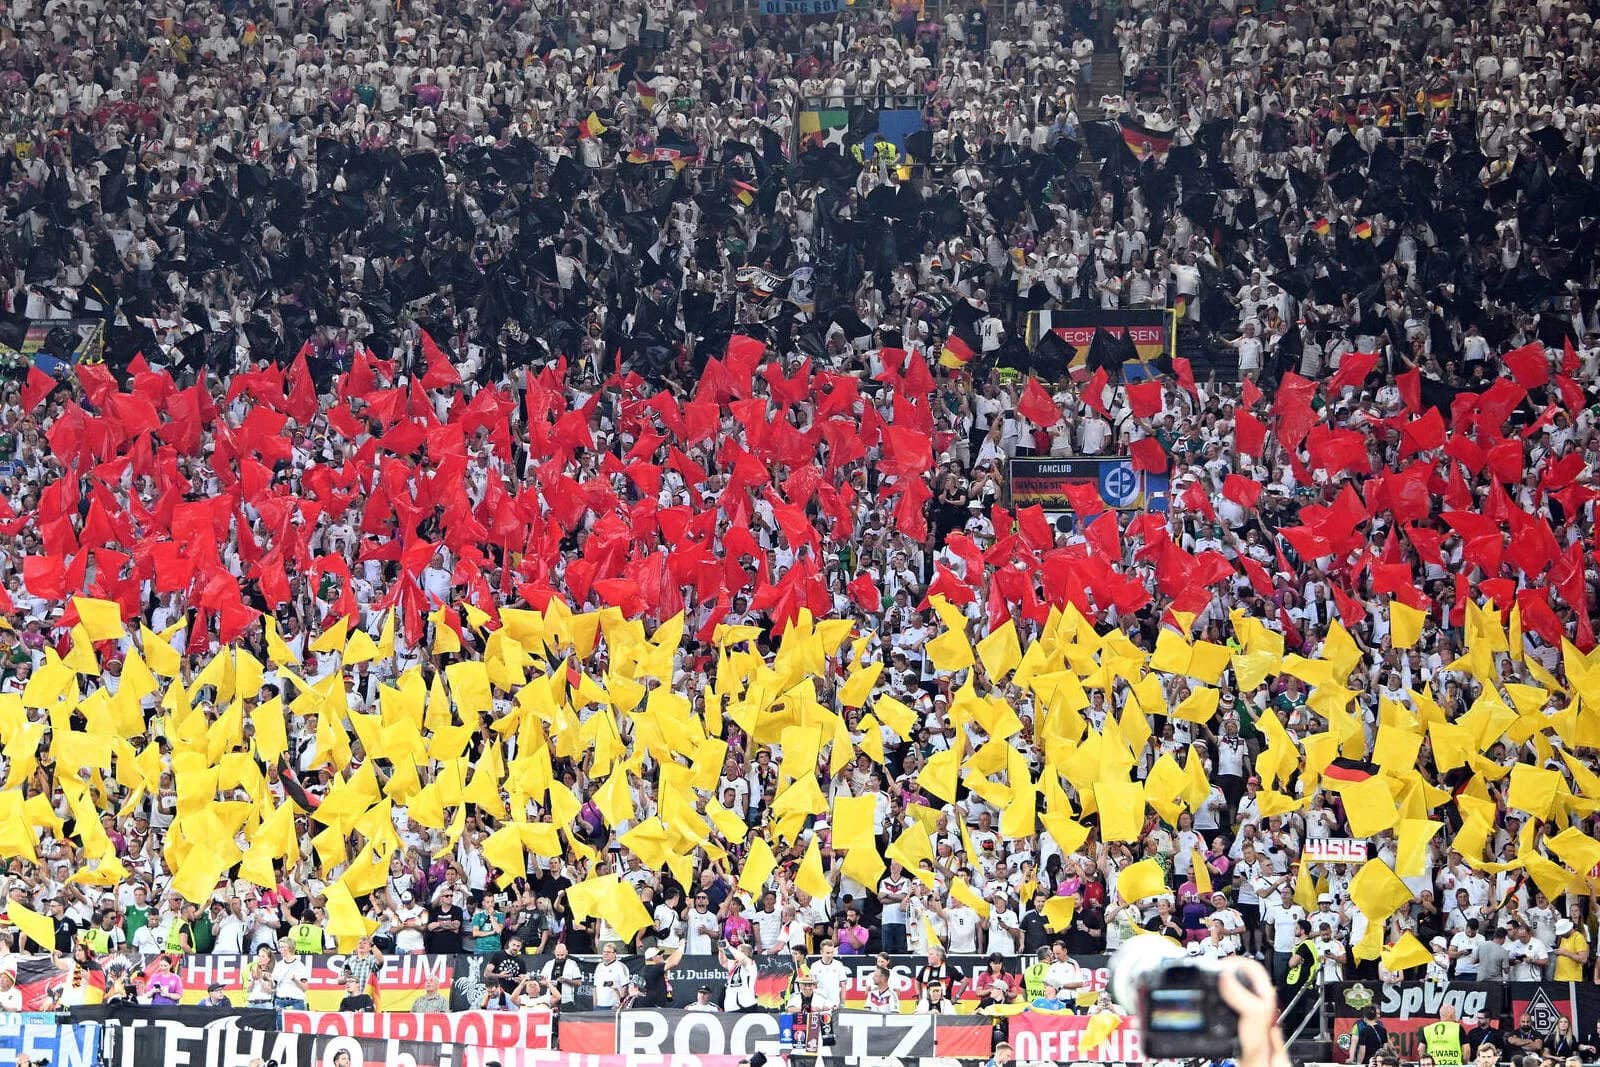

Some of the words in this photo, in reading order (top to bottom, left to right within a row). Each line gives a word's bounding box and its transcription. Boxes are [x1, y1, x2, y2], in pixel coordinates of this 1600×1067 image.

[1056, 330, 1159, 342] ECHSEN
[1038, 464, 1072, 473] FANCLUB
[187, 954, 447, 985] HEILSEIM
[687, 969, 730, 980] Duisbu
[620, 1011, 932, 1056] ROGTZ
[1015, 1030, 1145, 1062] OFFNB
